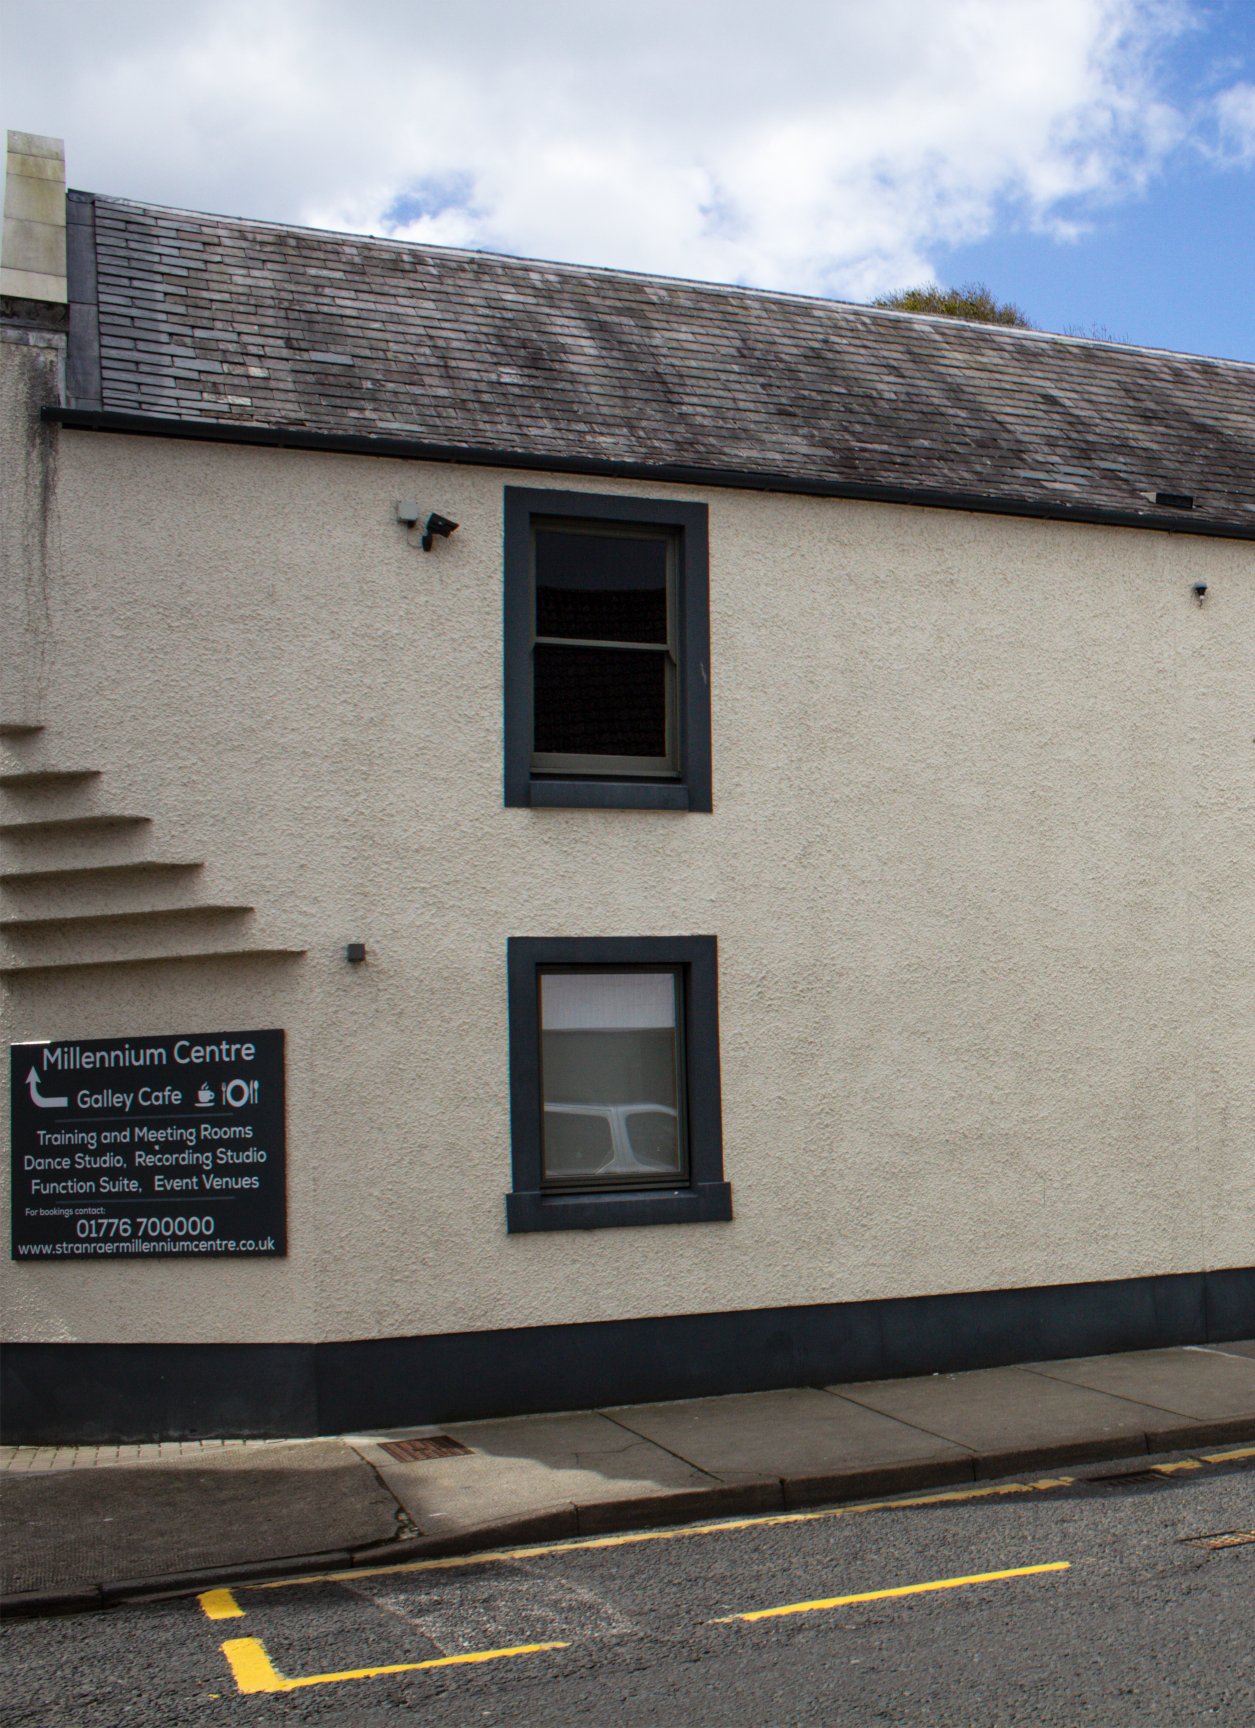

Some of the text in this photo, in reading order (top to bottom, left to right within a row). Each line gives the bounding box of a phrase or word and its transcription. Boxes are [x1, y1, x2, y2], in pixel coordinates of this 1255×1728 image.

[43, 1040, 256, 1071] Millennium Centre
[77, 1086, 182, 1112] Galley Cafe
[37, 1124, 253, 1150] Training and Meeting Rooms
[24, 1148, 267, 1171] Dance Studio, Recording Studio
[31, 1174, 260, 1195] Function Suite, Event Venues
[25, 1206, 106, 1218] For bookings contact:
[76, 1216, 215, 1238] 01776 700000
[18, 1236, 275, 1255] www.stranraermillenniumcentre.co.uk
